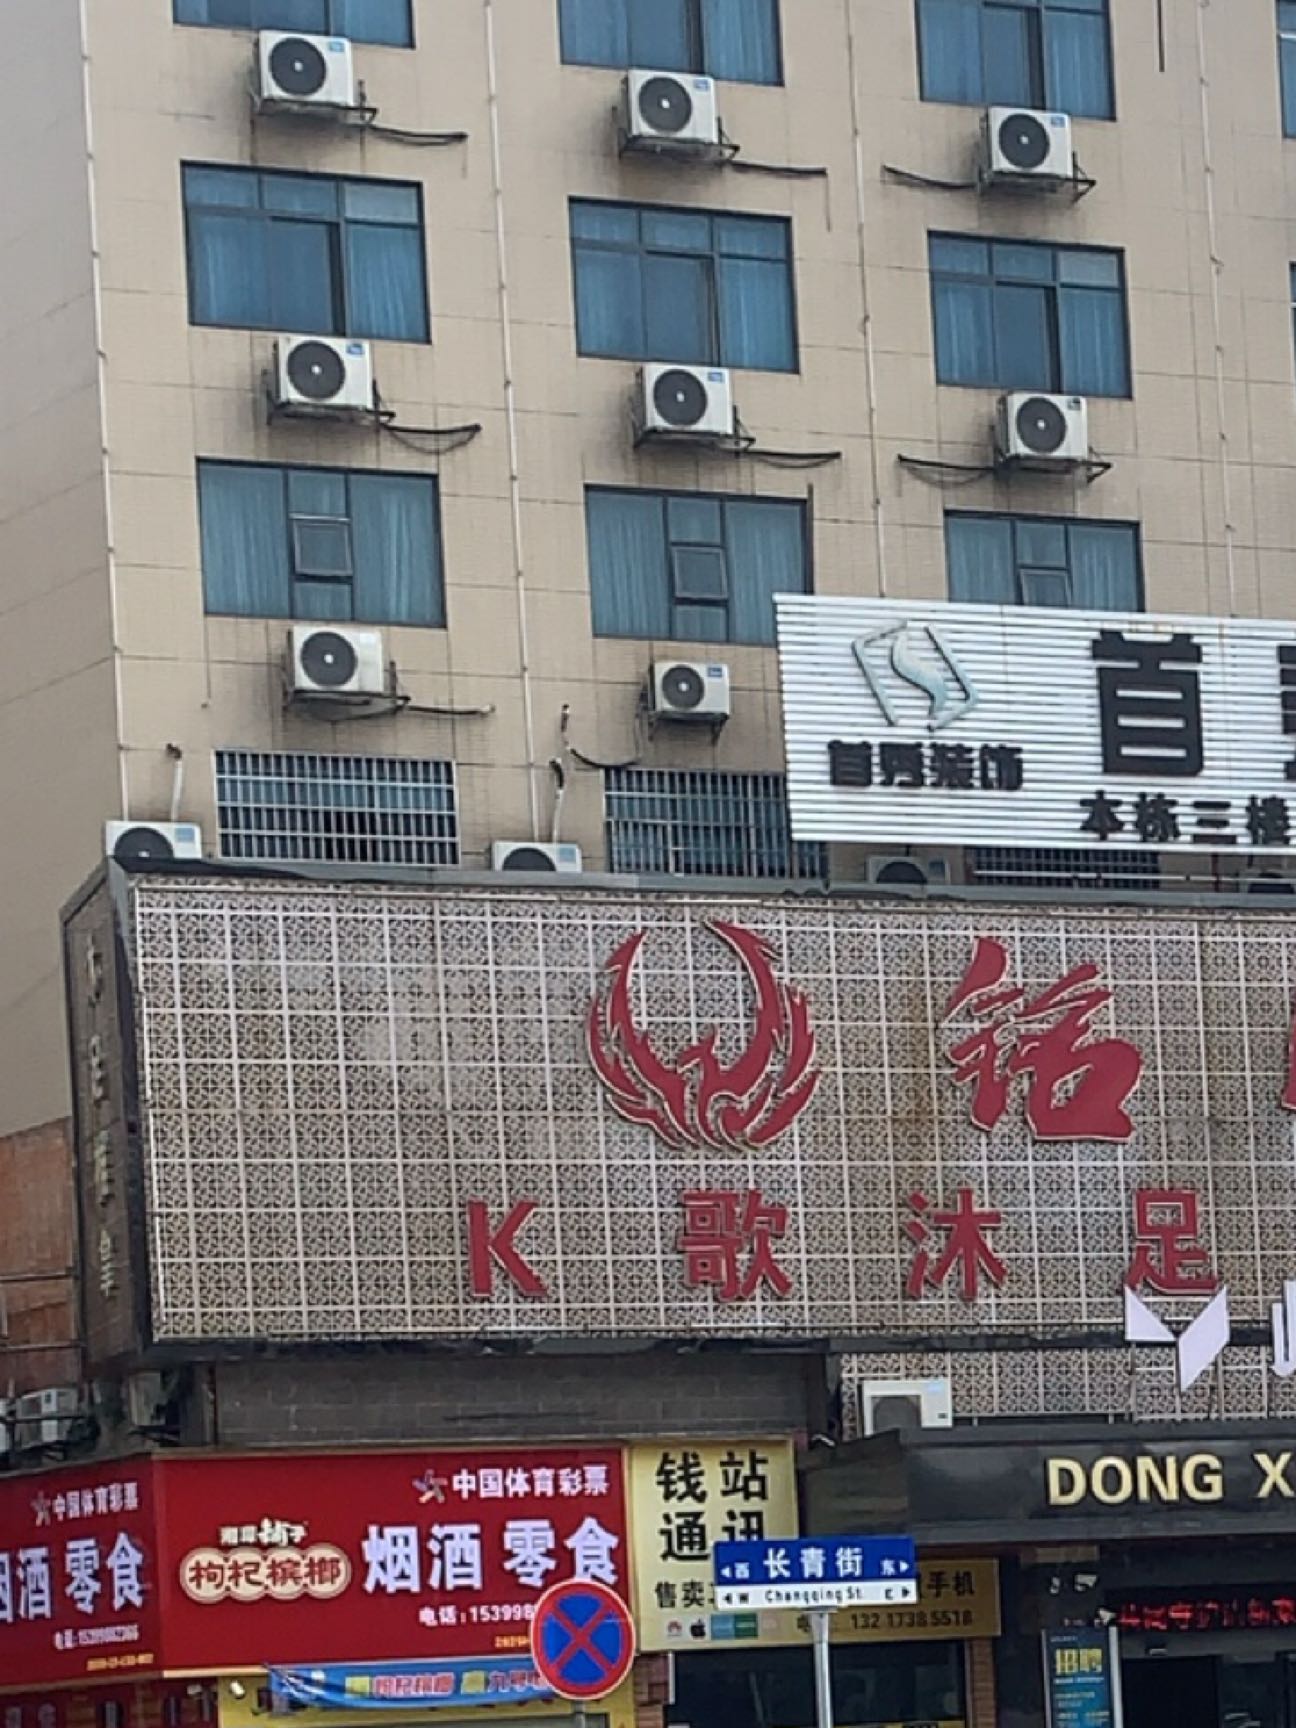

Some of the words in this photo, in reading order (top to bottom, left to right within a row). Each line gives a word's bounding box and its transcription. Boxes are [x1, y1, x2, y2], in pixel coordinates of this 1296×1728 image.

[827, 739, 1024, 791] 首秀装饰
[1079, 789, 1291, 845] 本栋三楼
[452, 1464, 609, 1500] 中国体育彩票
[656, 1450, 769, 1503] 钱站
[1046, 1453, 1225, 1505] DONG
[65, 1531, 144, 1614] 零食
[188, 1556, 342, 1590] 枸杞槟榔
[361, 1522, 483, 1594] 烟酒
[502, 1515, 620, 1588] 零食
[763, 1547, 863, 1579] 长青街
